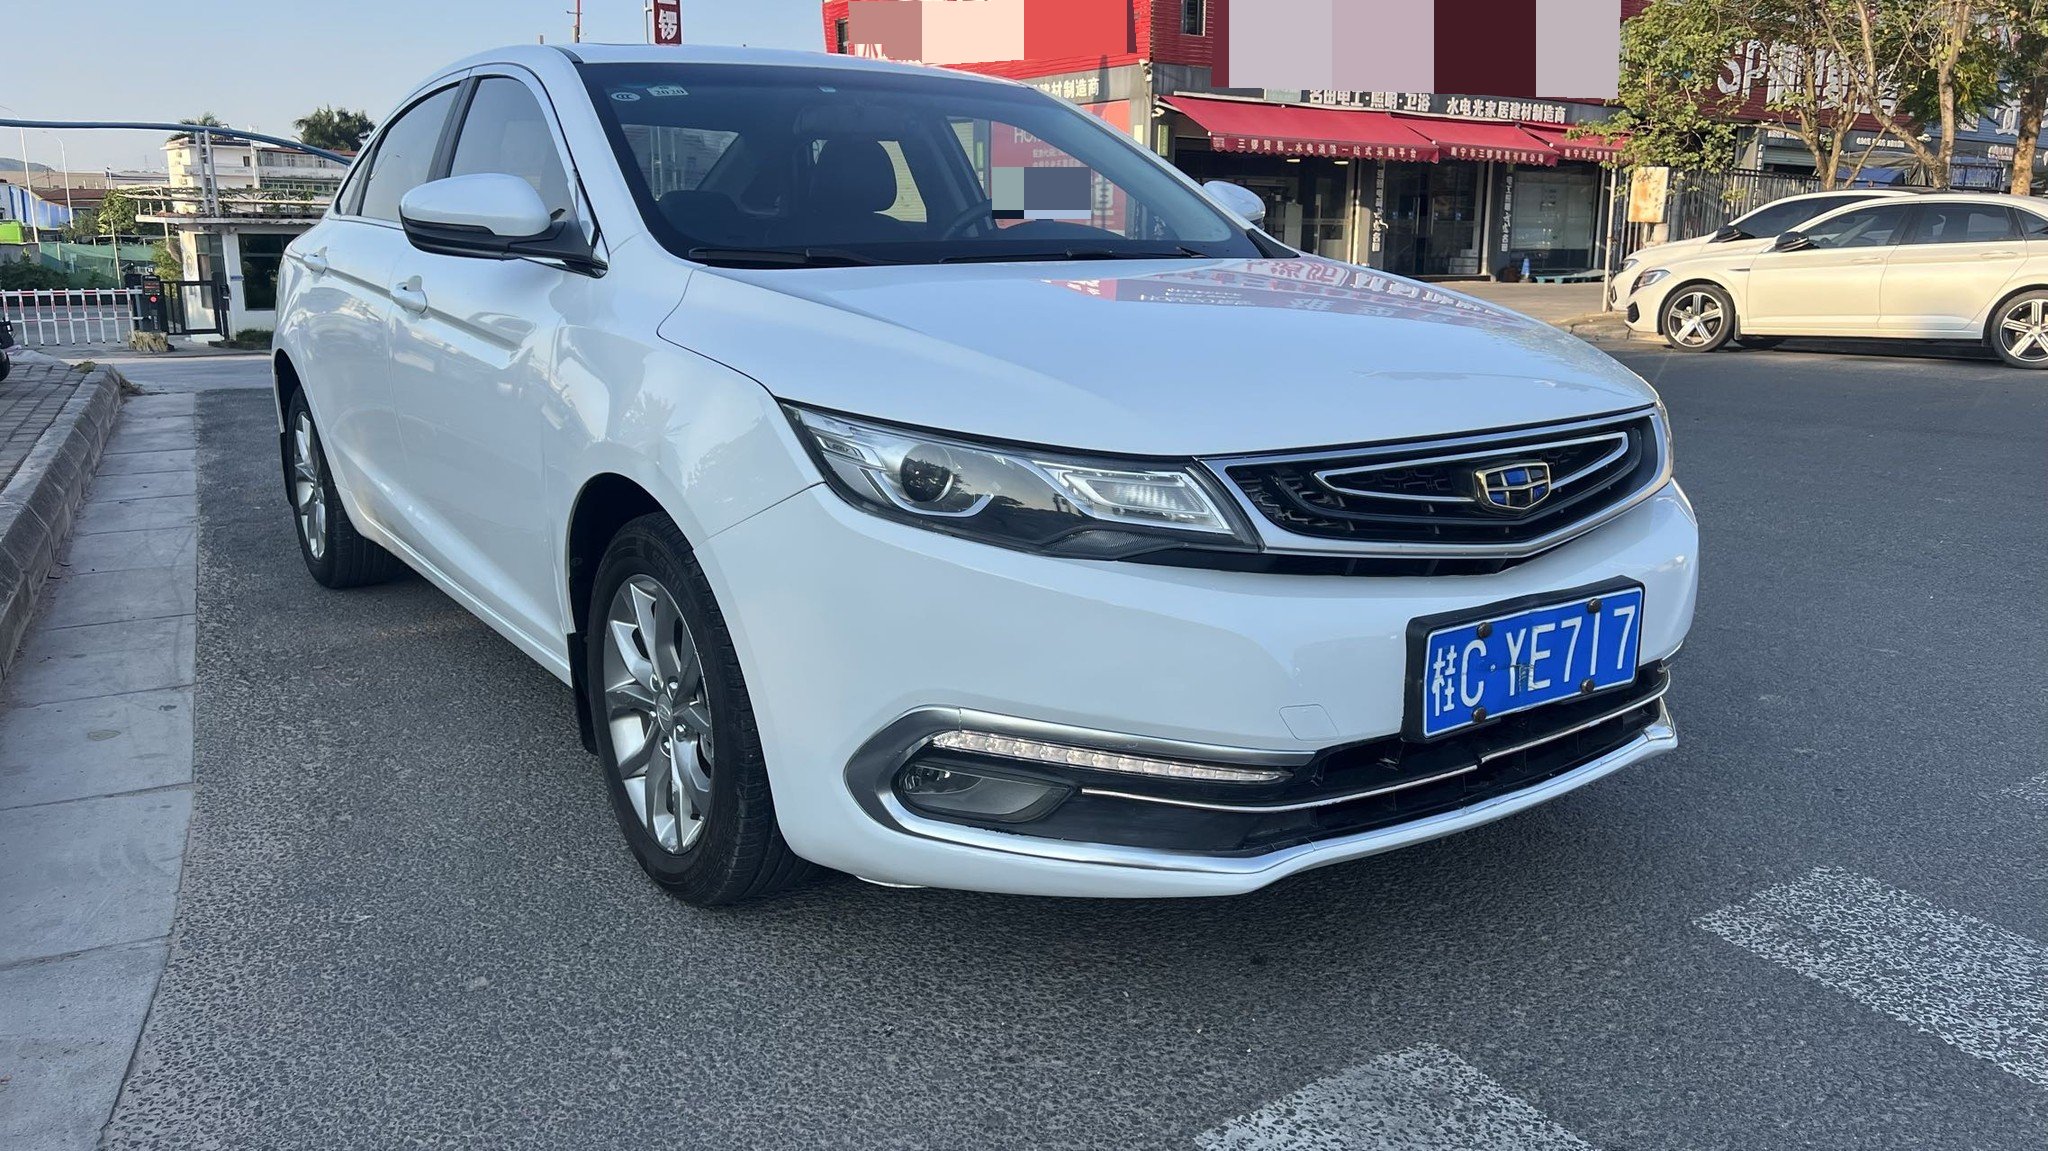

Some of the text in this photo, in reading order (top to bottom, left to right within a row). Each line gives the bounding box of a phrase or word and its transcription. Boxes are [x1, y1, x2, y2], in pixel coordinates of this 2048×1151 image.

[658, 0, 678, 40] 锣
[1446, 96, 1566, 124] 水电光家居建材制造商
